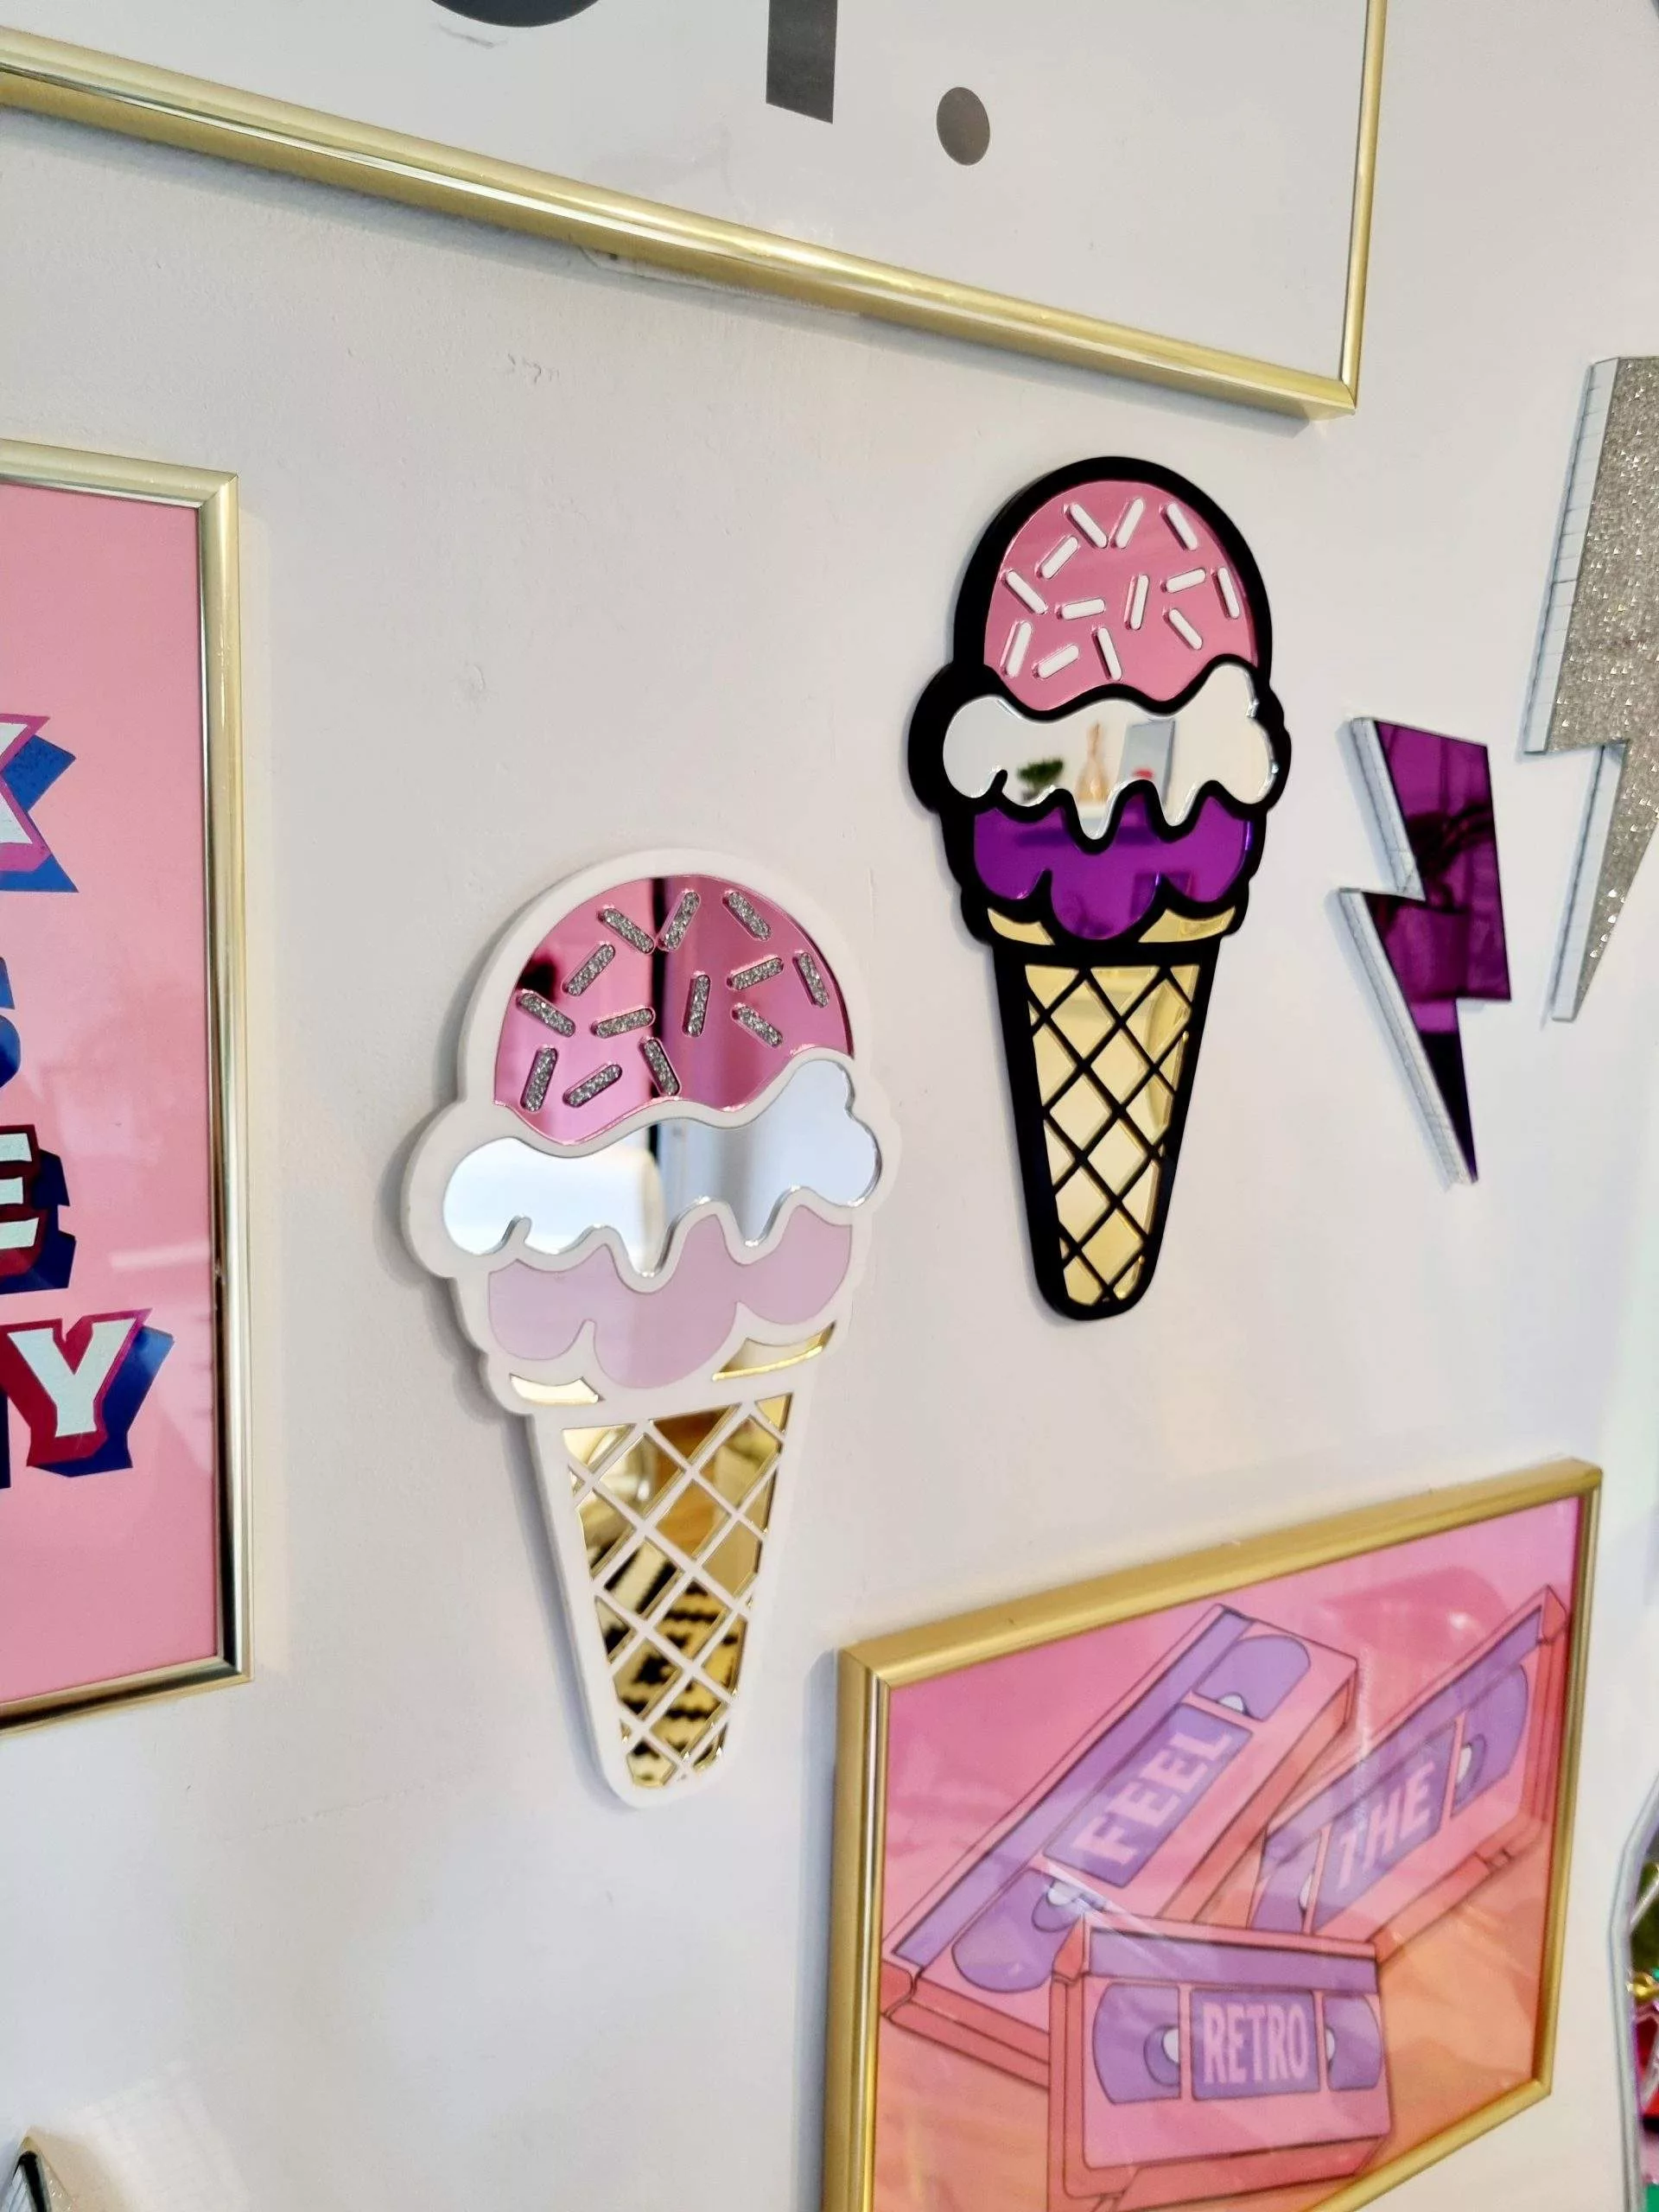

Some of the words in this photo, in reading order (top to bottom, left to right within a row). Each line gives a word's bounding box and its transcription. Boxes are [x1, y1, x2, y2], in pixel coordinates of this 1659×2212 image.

[1071, 1731, 1233, 1865] FEEL
[1337, 1760, 1437, 1891] THE
[1203, 2002, 1309, 2084] RETRO
